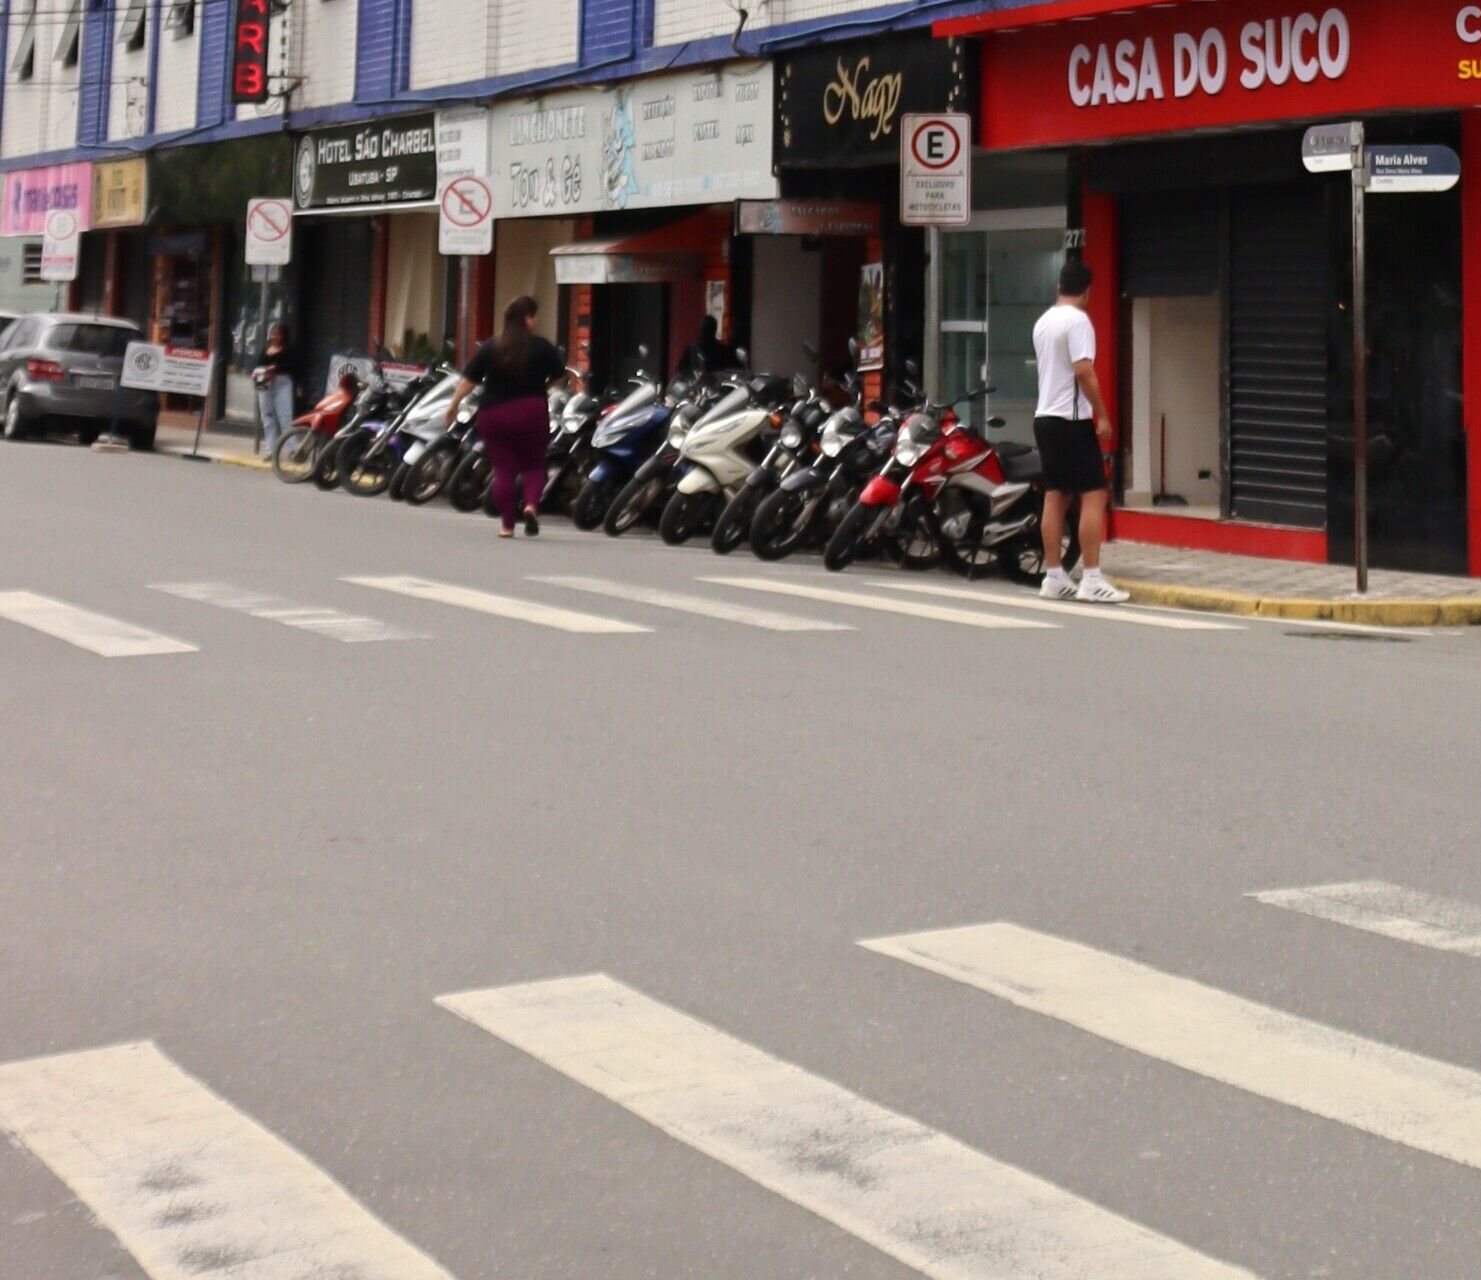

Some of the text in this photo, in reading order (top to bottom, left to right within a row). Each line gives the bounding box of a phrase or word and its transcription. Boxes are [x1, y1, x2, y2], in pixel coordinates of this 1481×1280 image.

[1068, 8, 1350, 107] CASA DO SUCO
[823, 56, 902, 140] Nagy
[317, 138, 352, 164] HOTEL
[382, 127, 434, 158] CHARBEL
[926, 131, 944, 159] E
[1375, 154, 1428, 166] Maria Alves
